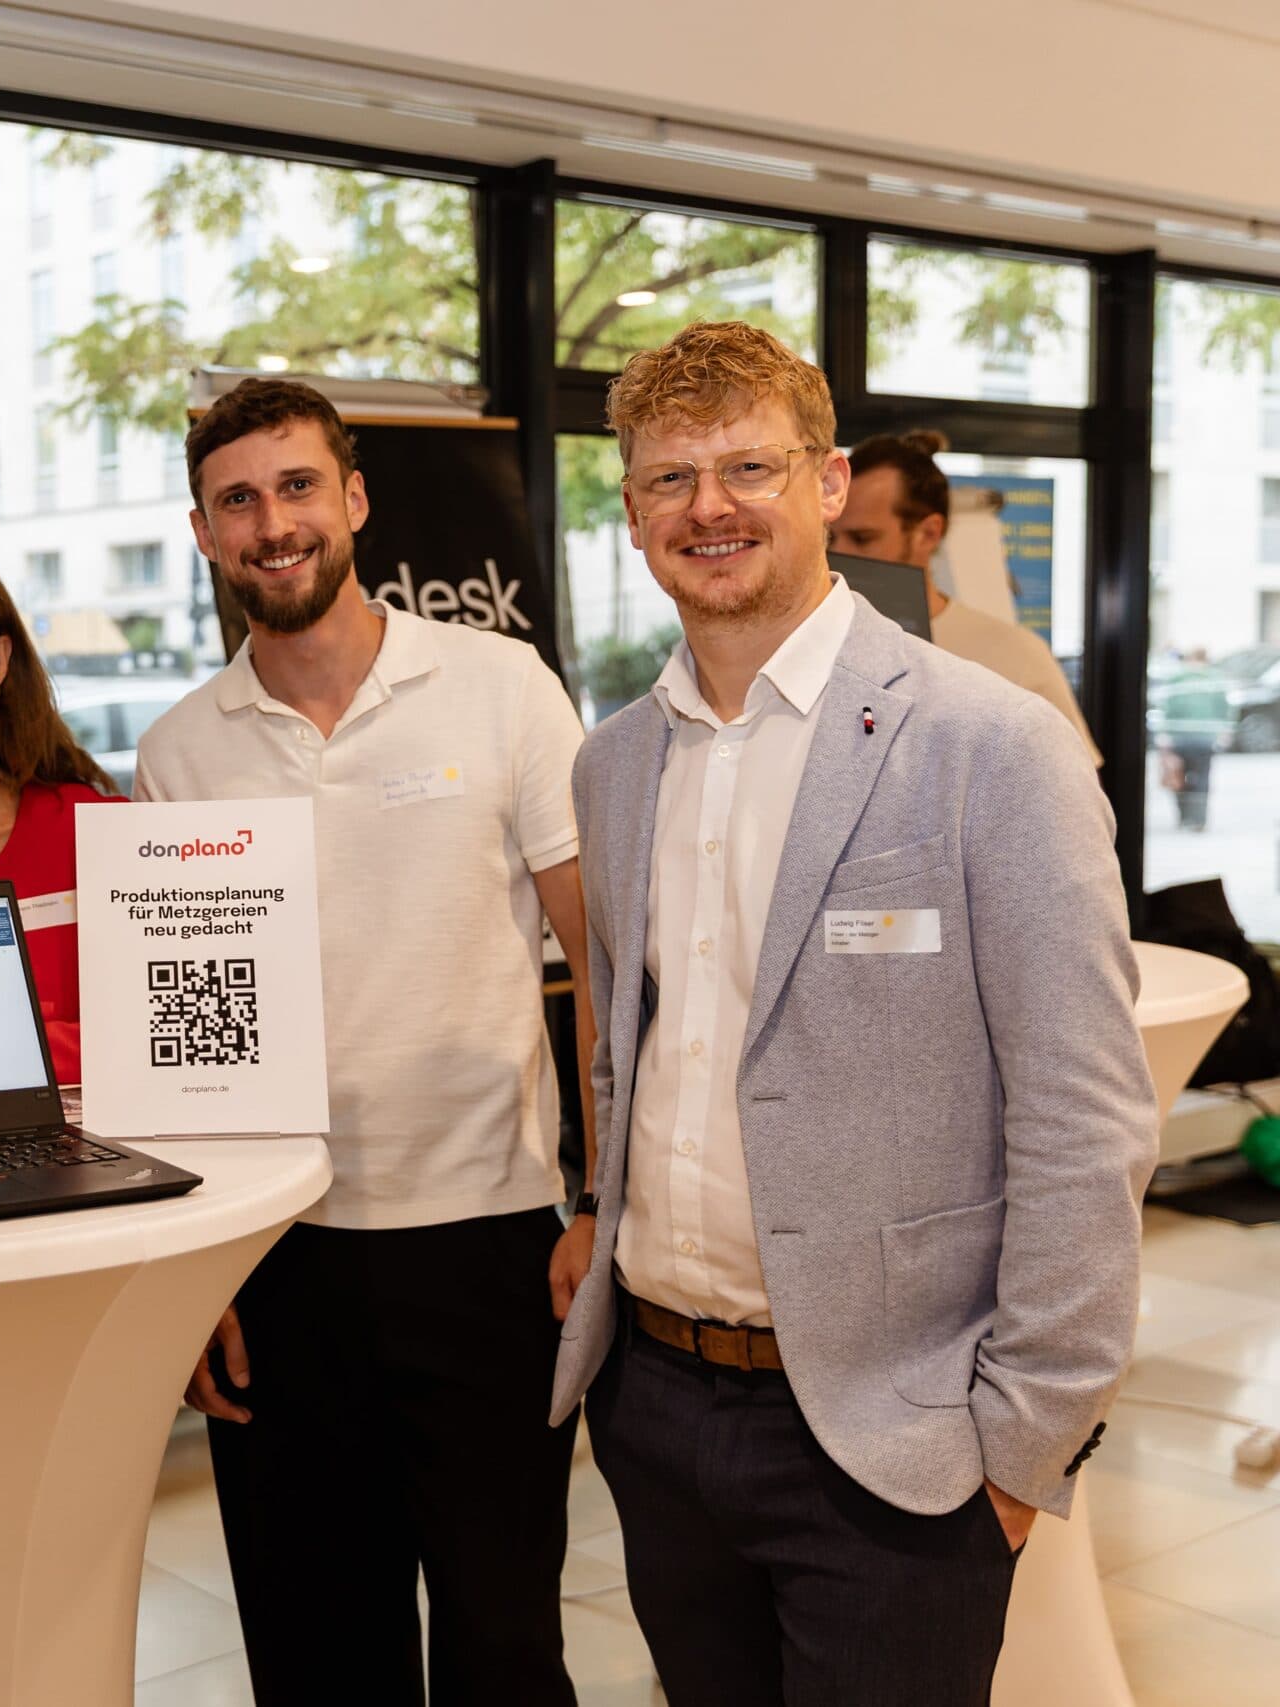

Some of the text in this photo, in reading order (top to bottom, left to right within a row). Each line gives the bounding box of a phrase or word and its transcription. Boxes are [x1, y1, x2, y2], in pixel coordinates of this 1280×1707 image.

[358, 557, 534, 630] desk
[138, 836, 245, 862] donplano
[110, 886, 285, 904] Produktionsplanung
[127, 903, 268, 921] für Metzgereien
[143, 920, 254, 940] neu gedacht
[181, 1084, 230, 1095] donplano.de
